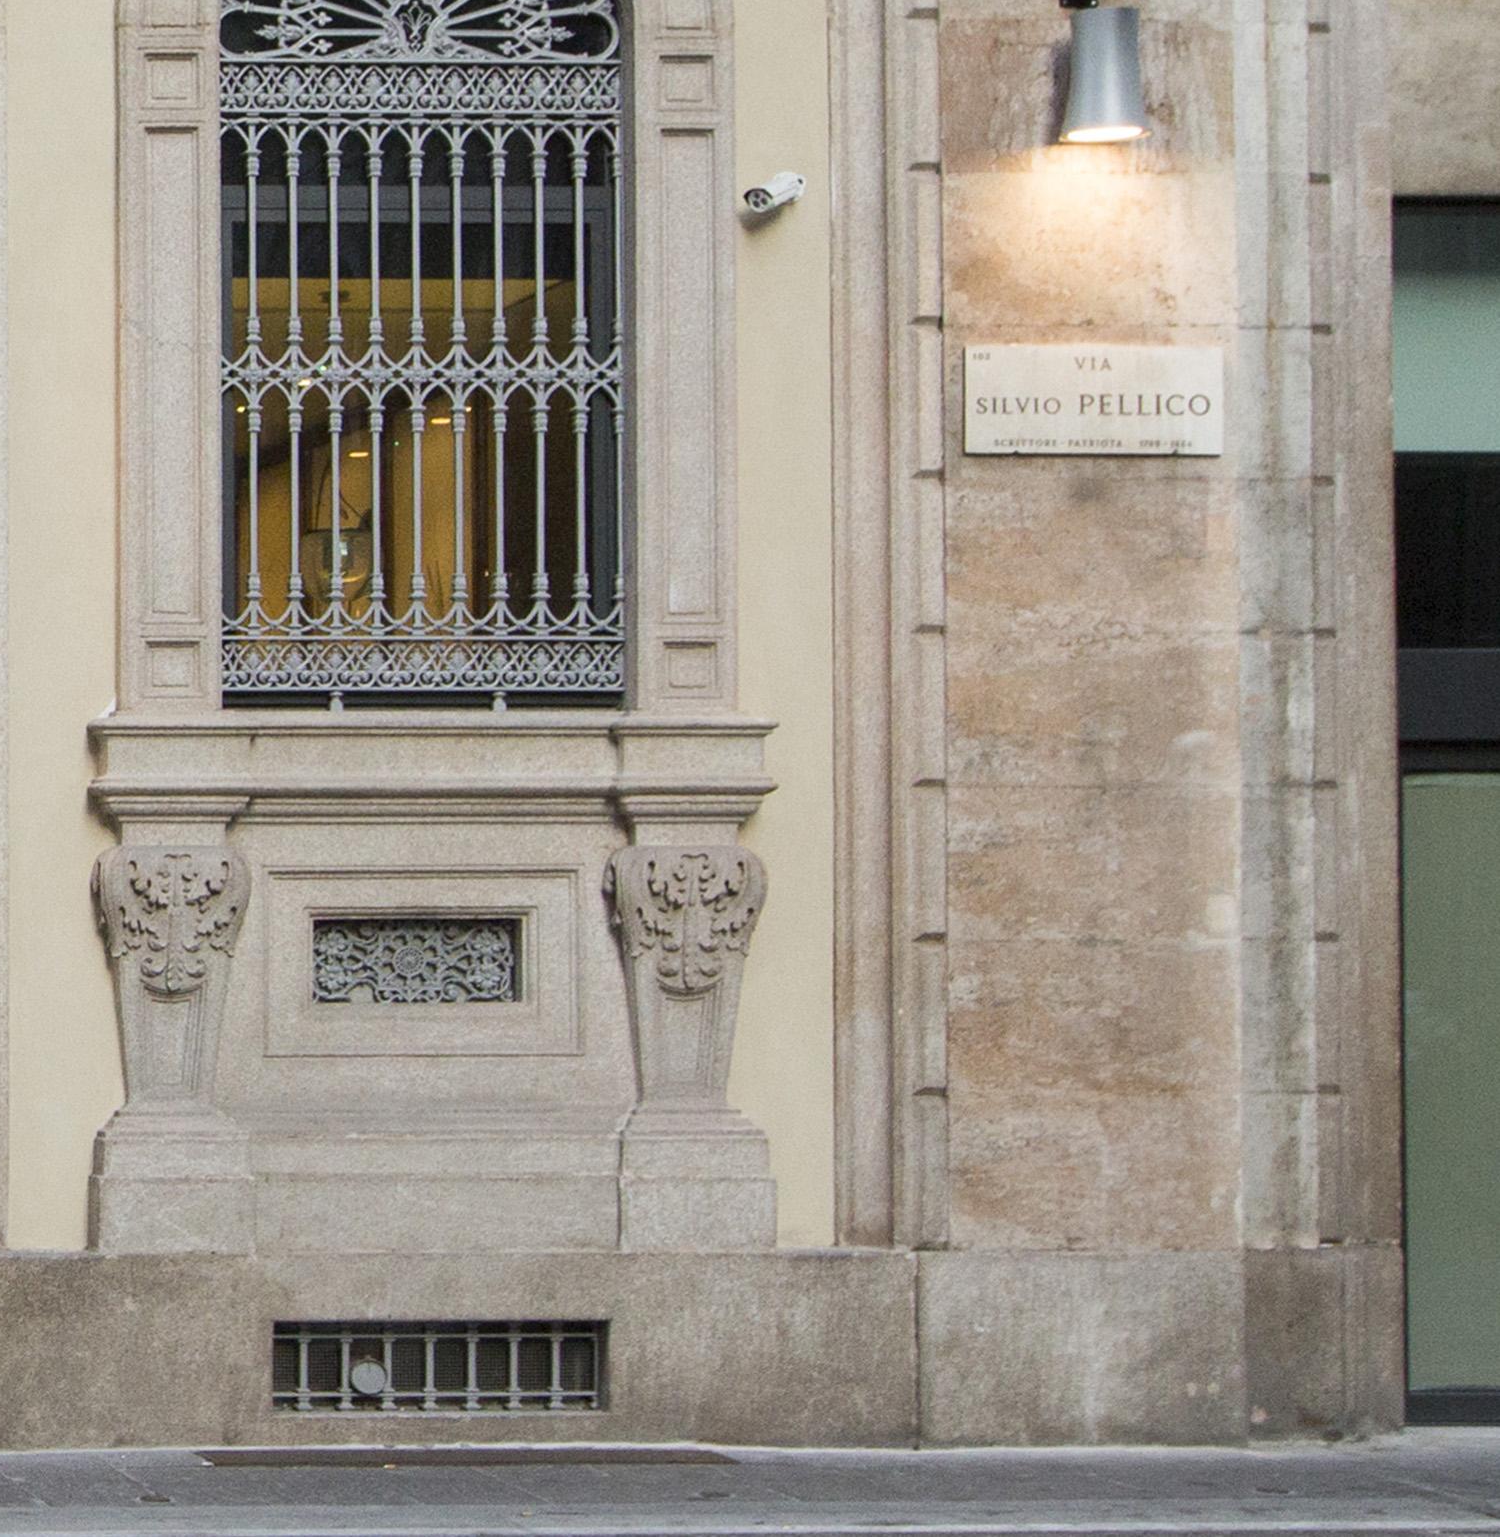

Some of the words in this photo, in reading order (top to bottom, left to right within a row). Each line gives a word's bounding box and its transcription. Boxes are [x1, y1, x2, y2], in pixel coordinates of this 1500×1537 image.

[1073, 356, 1113, 372] VIA
[975, 396, 1063, 416] SILVIO
[1078, 393, 1212, 418] PELLICO
